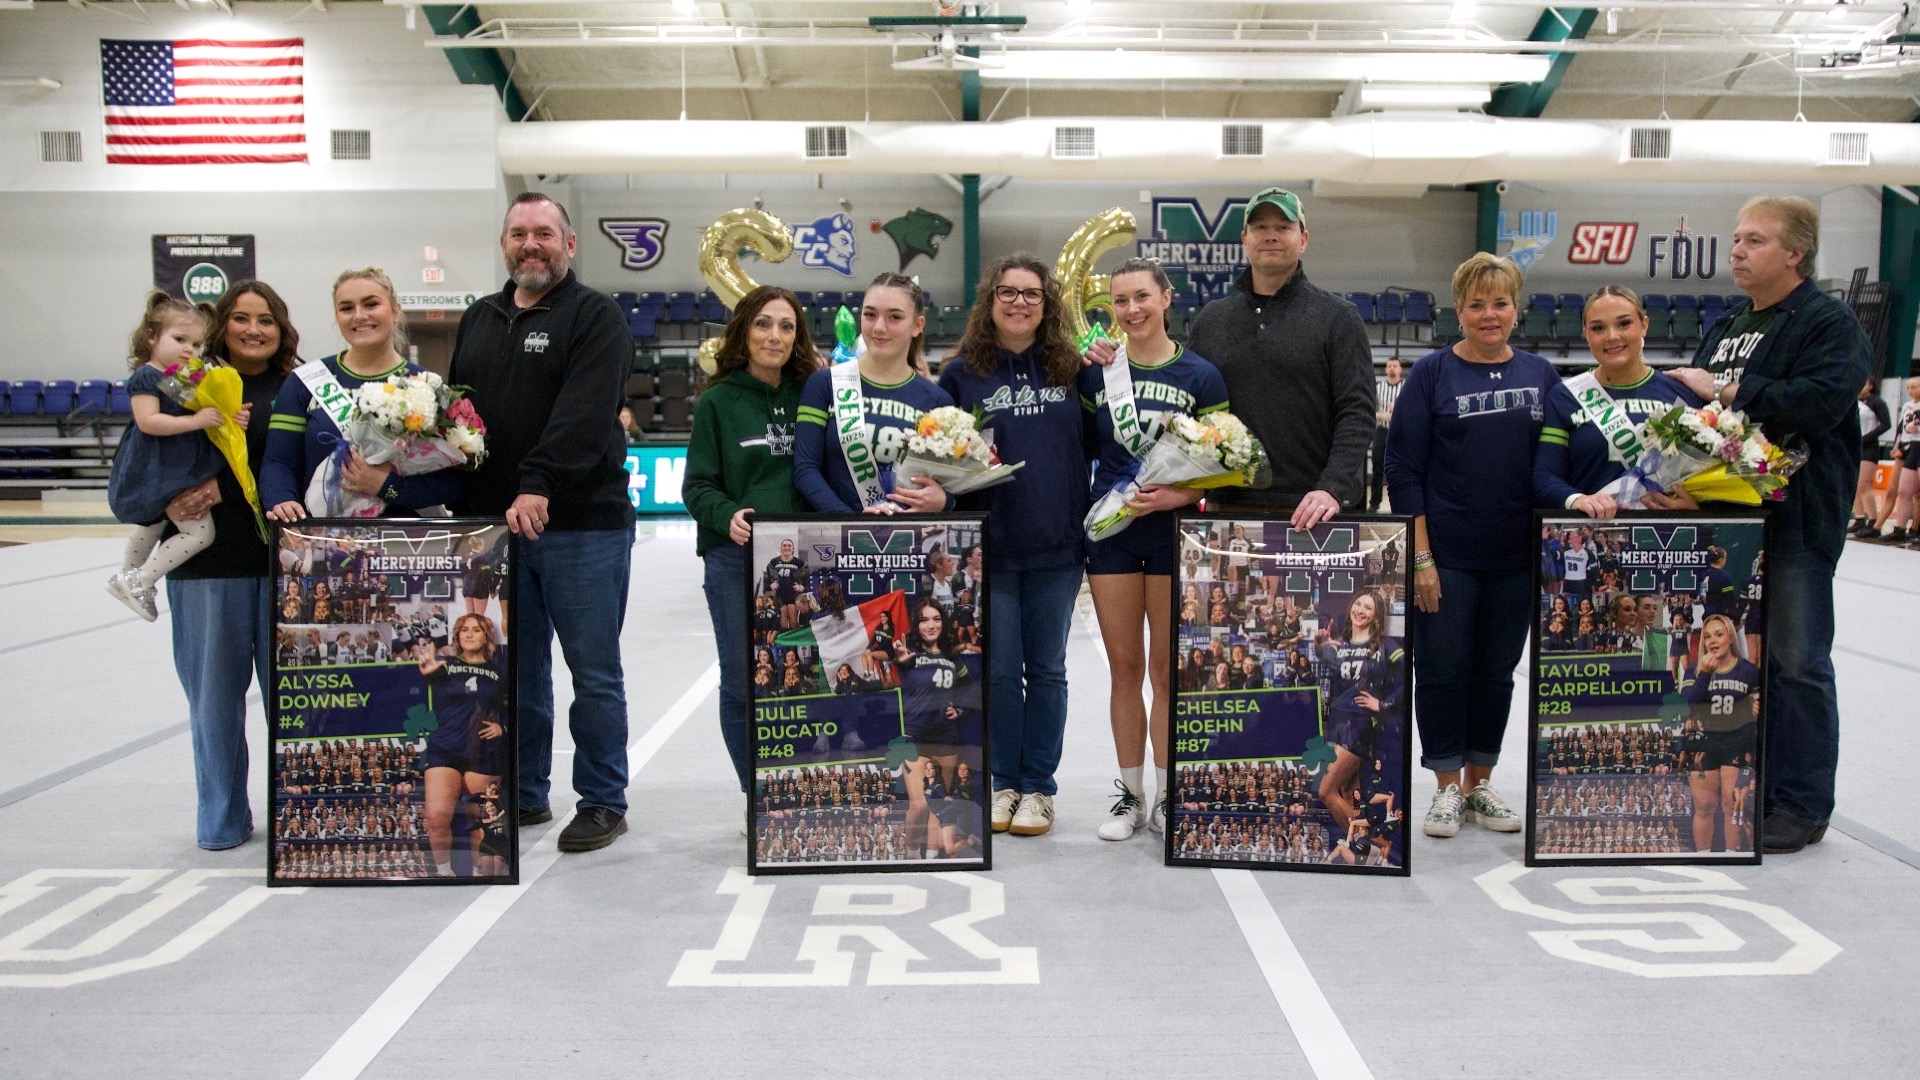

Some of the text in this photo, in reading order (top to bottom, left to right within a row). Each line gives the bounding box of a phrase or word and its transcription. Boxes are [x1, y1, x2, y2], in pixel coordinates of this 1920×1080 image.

[1498, 210, 1557, 241] LIU
[166, 235, 229, 245] NATIONAL SUICIDE
[1570, 222, 1637, 264] SFU
[170, 247, 244, 257] PREVENTION LIFELINE
[1650, 233, 1718, 279] FDU
[1187, 264, 1234, 272] UNIVERSITY
[190, 276, 223, 294] 988
[1458, 388, 1539, 415] STUNT
[1014, 405, 1045, 416] STUNT
[1875, 469, 1884, 483] G
[369, 556, 462, 570] MERCYHURST
[837, 554, 926, 568] MERCYHURST
[1621, 550, 1708, 564] MERCYHURST
[1748, 583, 1762, 600] 28
[1340, 660, 1363, 680] 87
[1539, 663, 1611, 678] TAYLOR
[278, 673, 354, 690] ALYSSA
[465, 676, 478, 692] 4
[932, 668, 954, 689] 48
[1538, 680, 1662, 697] CARPELLOTTI
[279, 692, 371, 710] DOWNEY
[1176, 699, 1261, 715] CHELSEA
[1538, 700, 1572, 715] #28
[1711, 694, 1735, 715] 28
[756, 704, 807, 722] JULIE
[279, 714, 305, 729] #4
[1176, 718, 1244, 734] HOEHN
[757, 722, 838, 740] DUCATO
[758, 744, 795, 759] #48
[1176, 738, 1210, 753] #87
